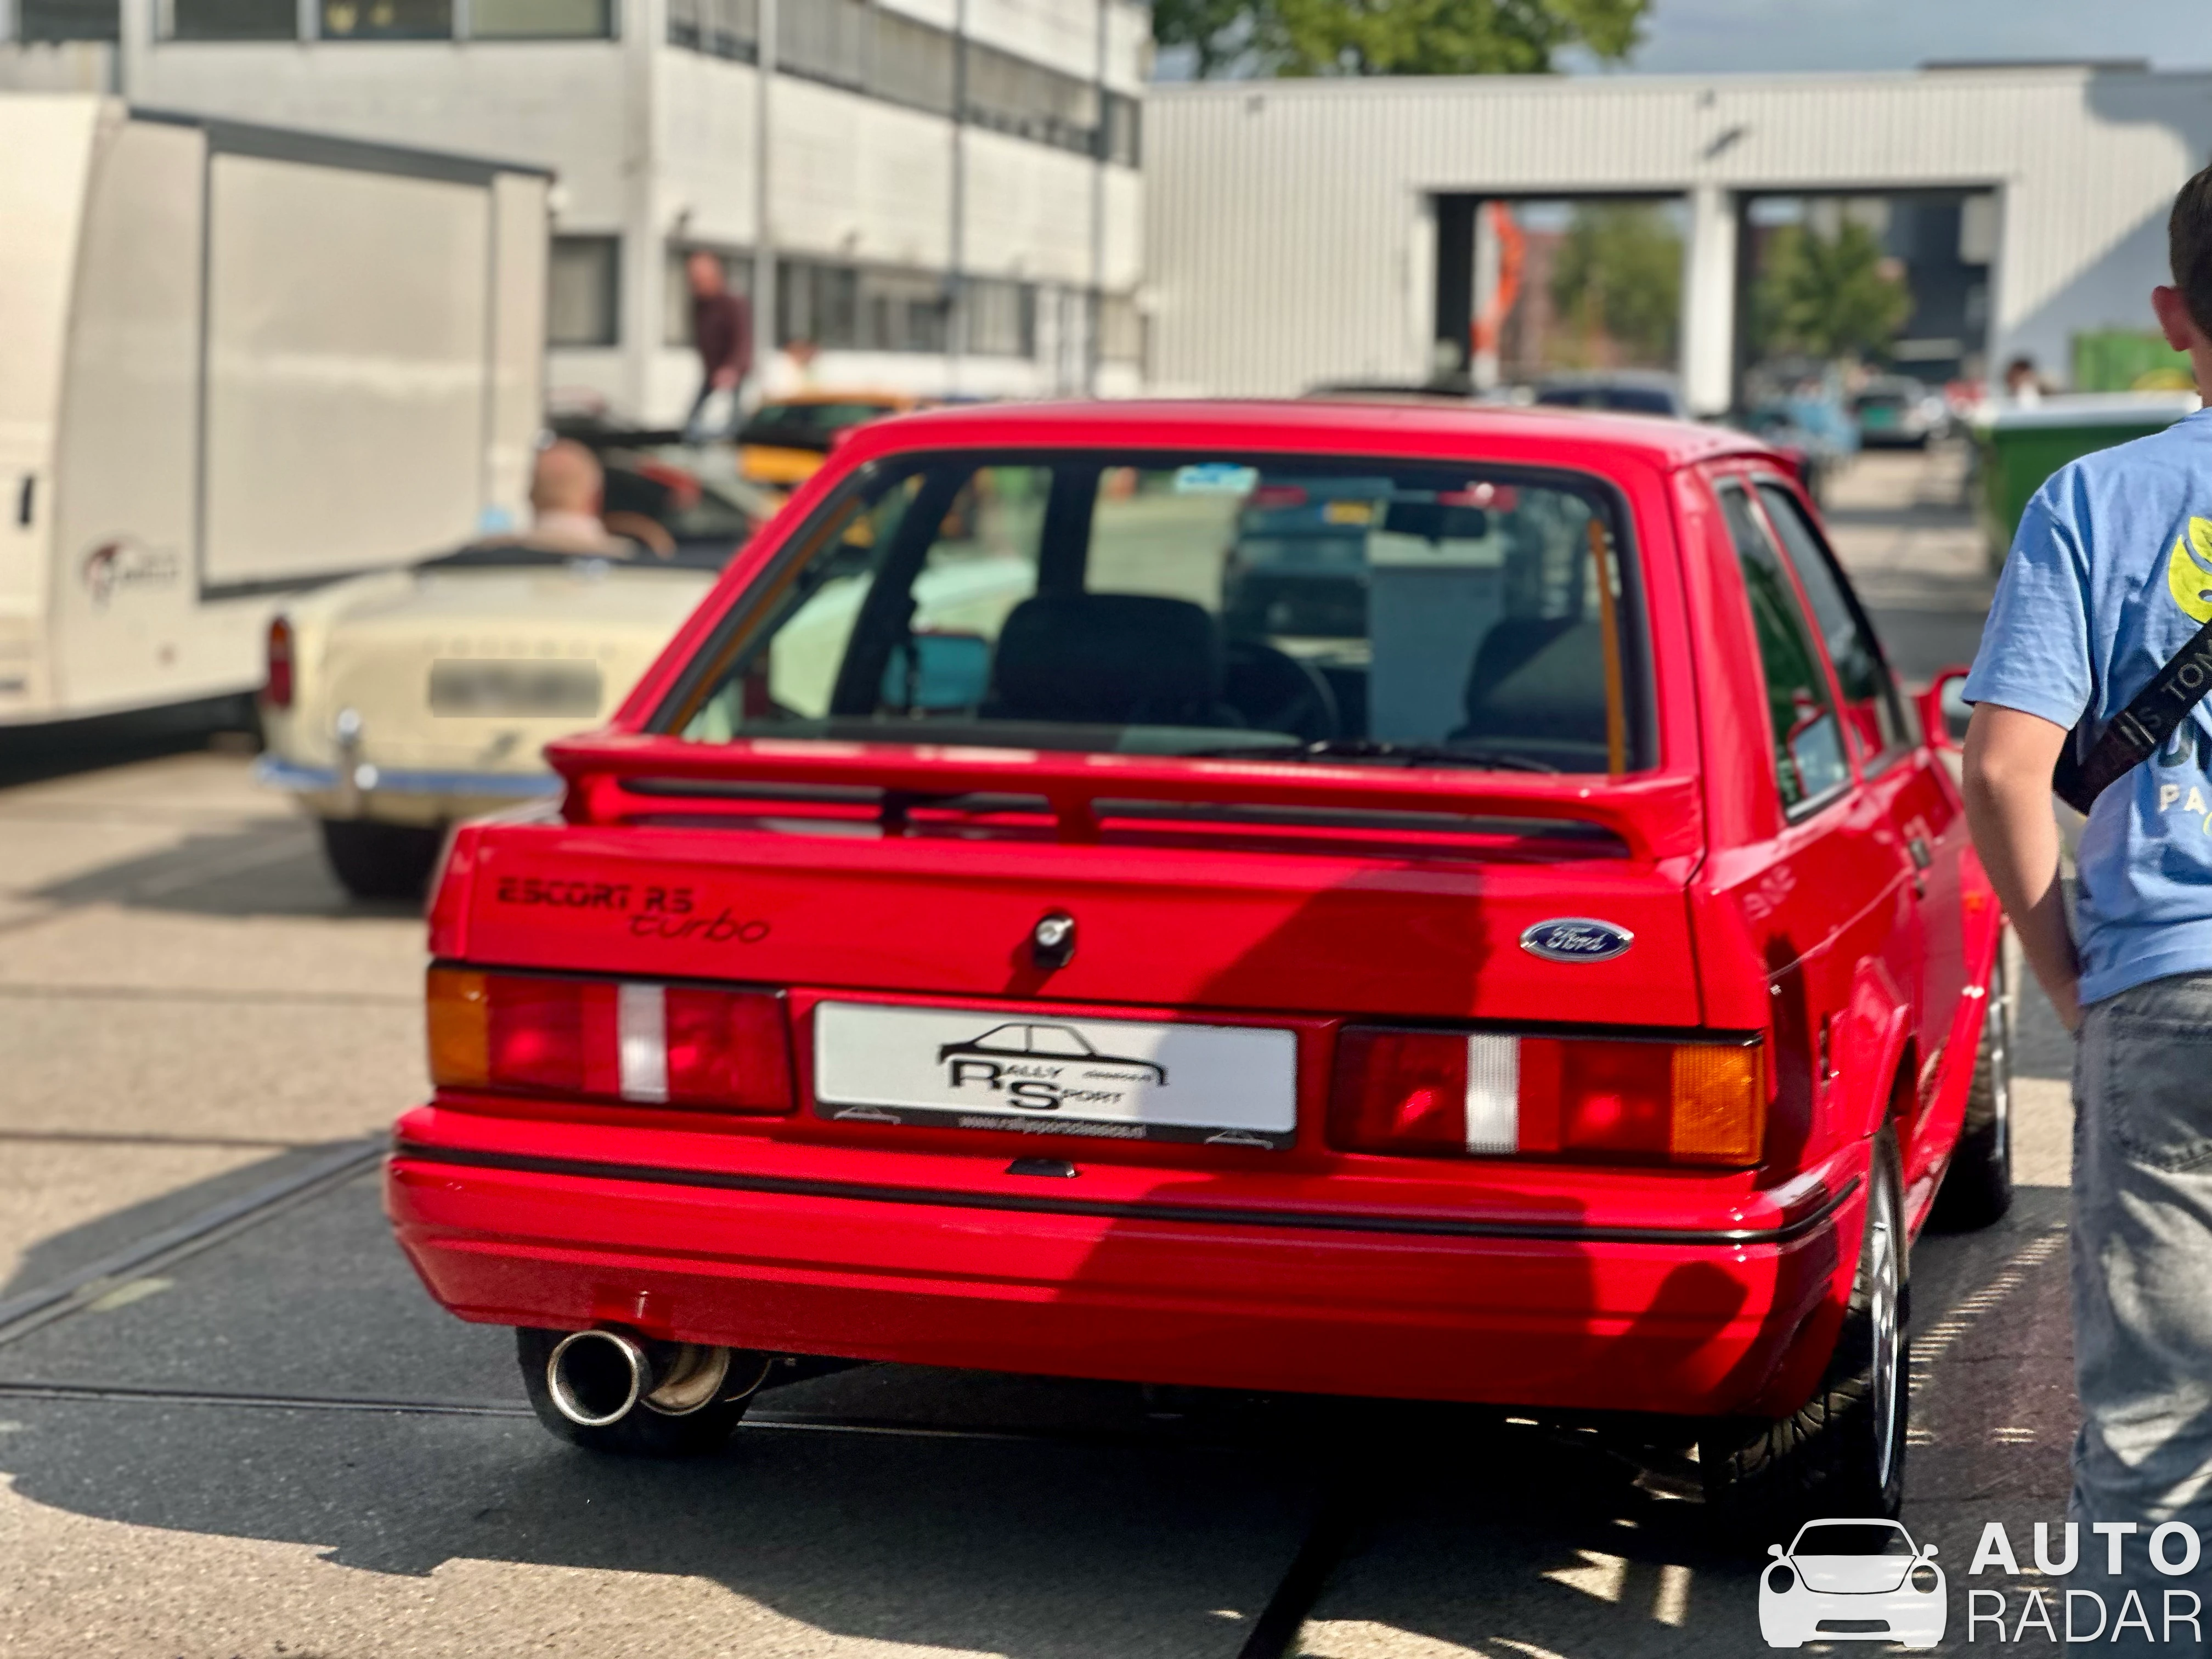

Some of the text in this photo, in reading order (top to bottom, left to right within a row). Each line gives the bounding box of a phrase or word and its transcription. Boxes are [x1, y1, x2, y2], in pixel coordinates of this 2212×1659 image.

[497, 876, 694, 914] ESCORT RS
[629, 908, 771, 944] turbo
[1546, 926, 1609, 951] Ford
